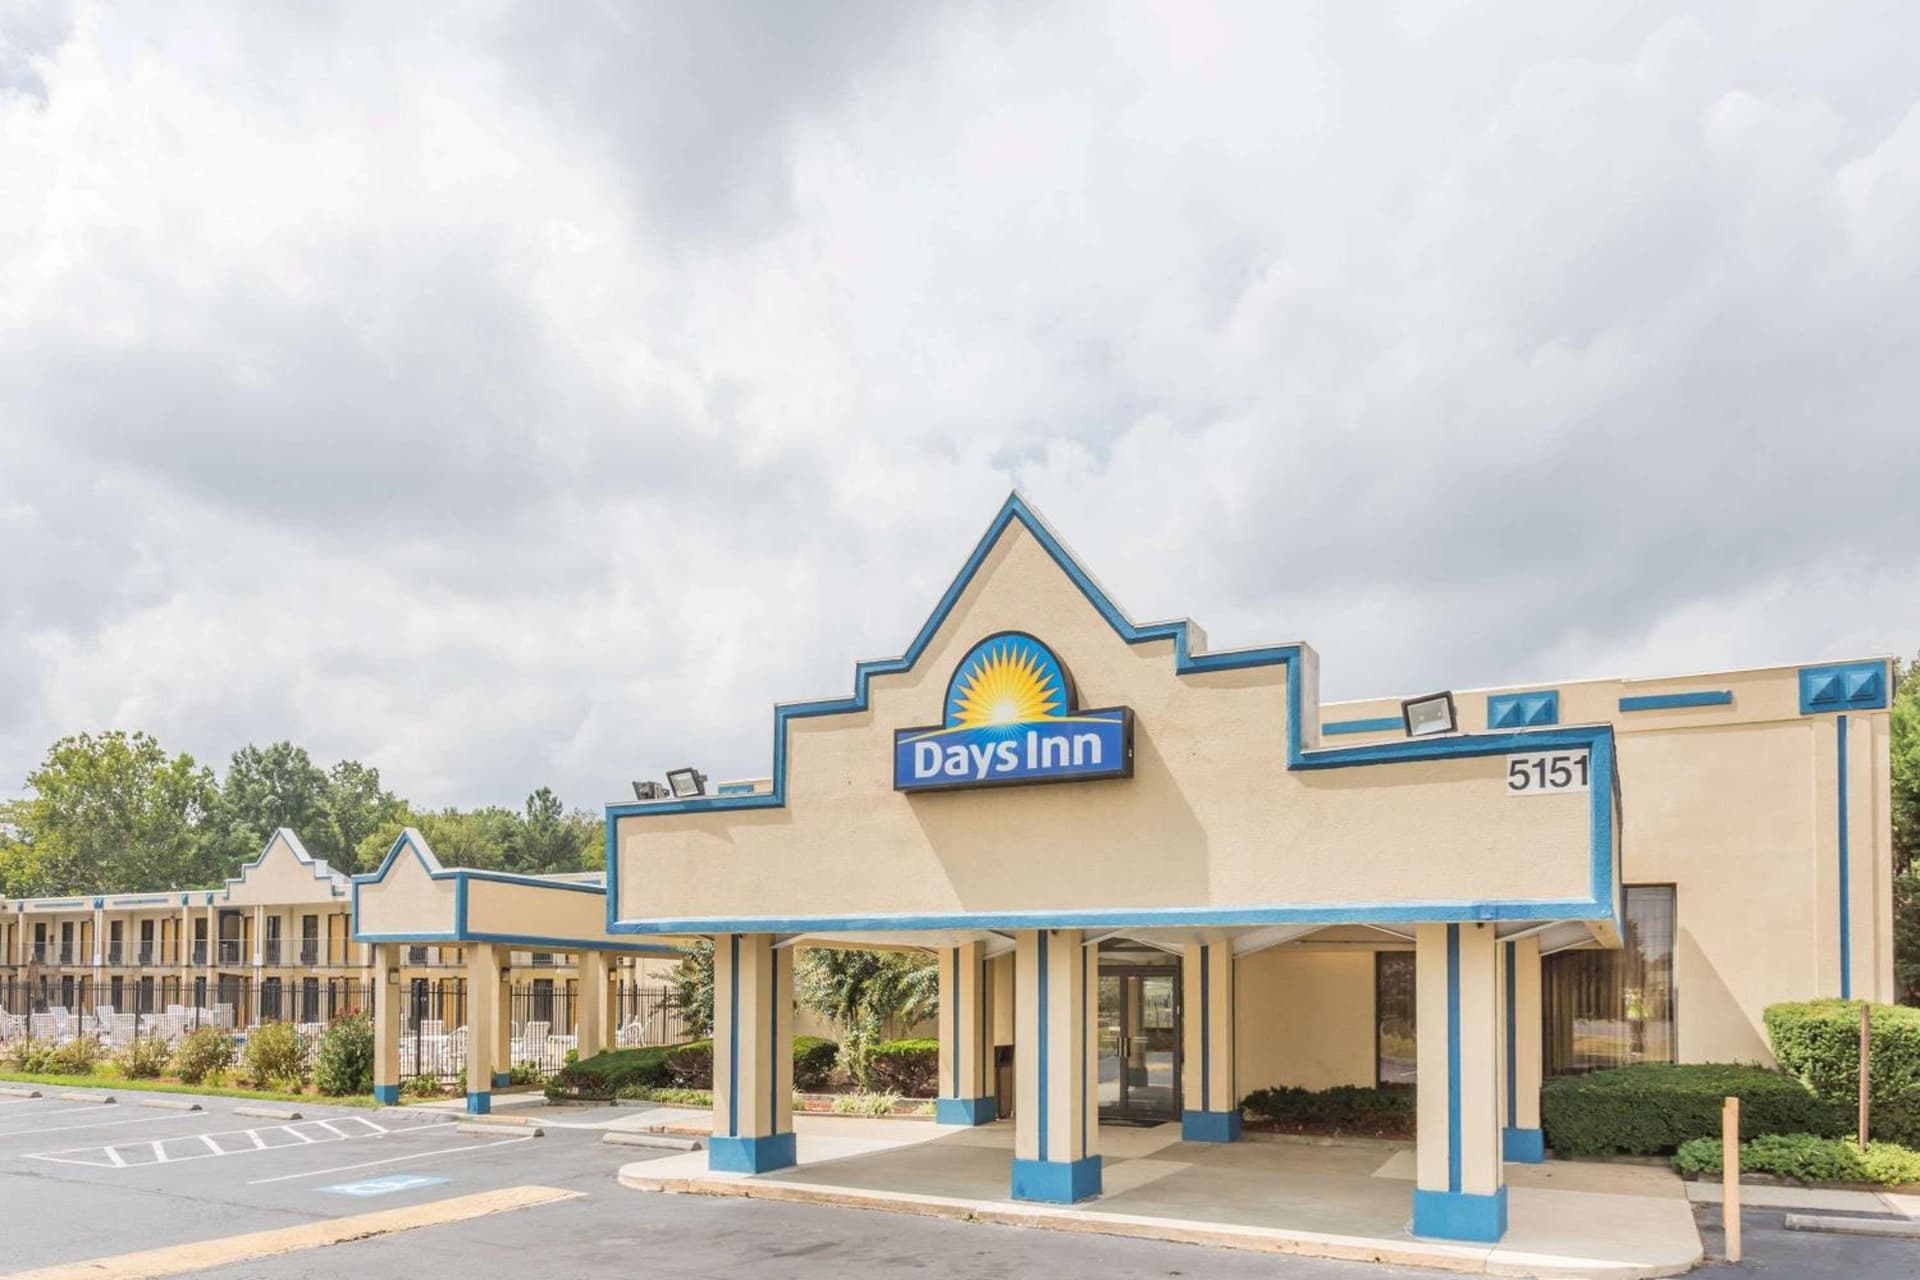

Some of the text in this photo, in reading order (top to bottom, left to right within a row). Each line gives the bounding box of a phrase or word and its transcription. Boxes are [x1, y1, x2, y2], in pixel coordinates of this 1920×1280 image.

[914, 731, 1101, 780] Days Inn
[1508, 755, 1588, 790] 5151
